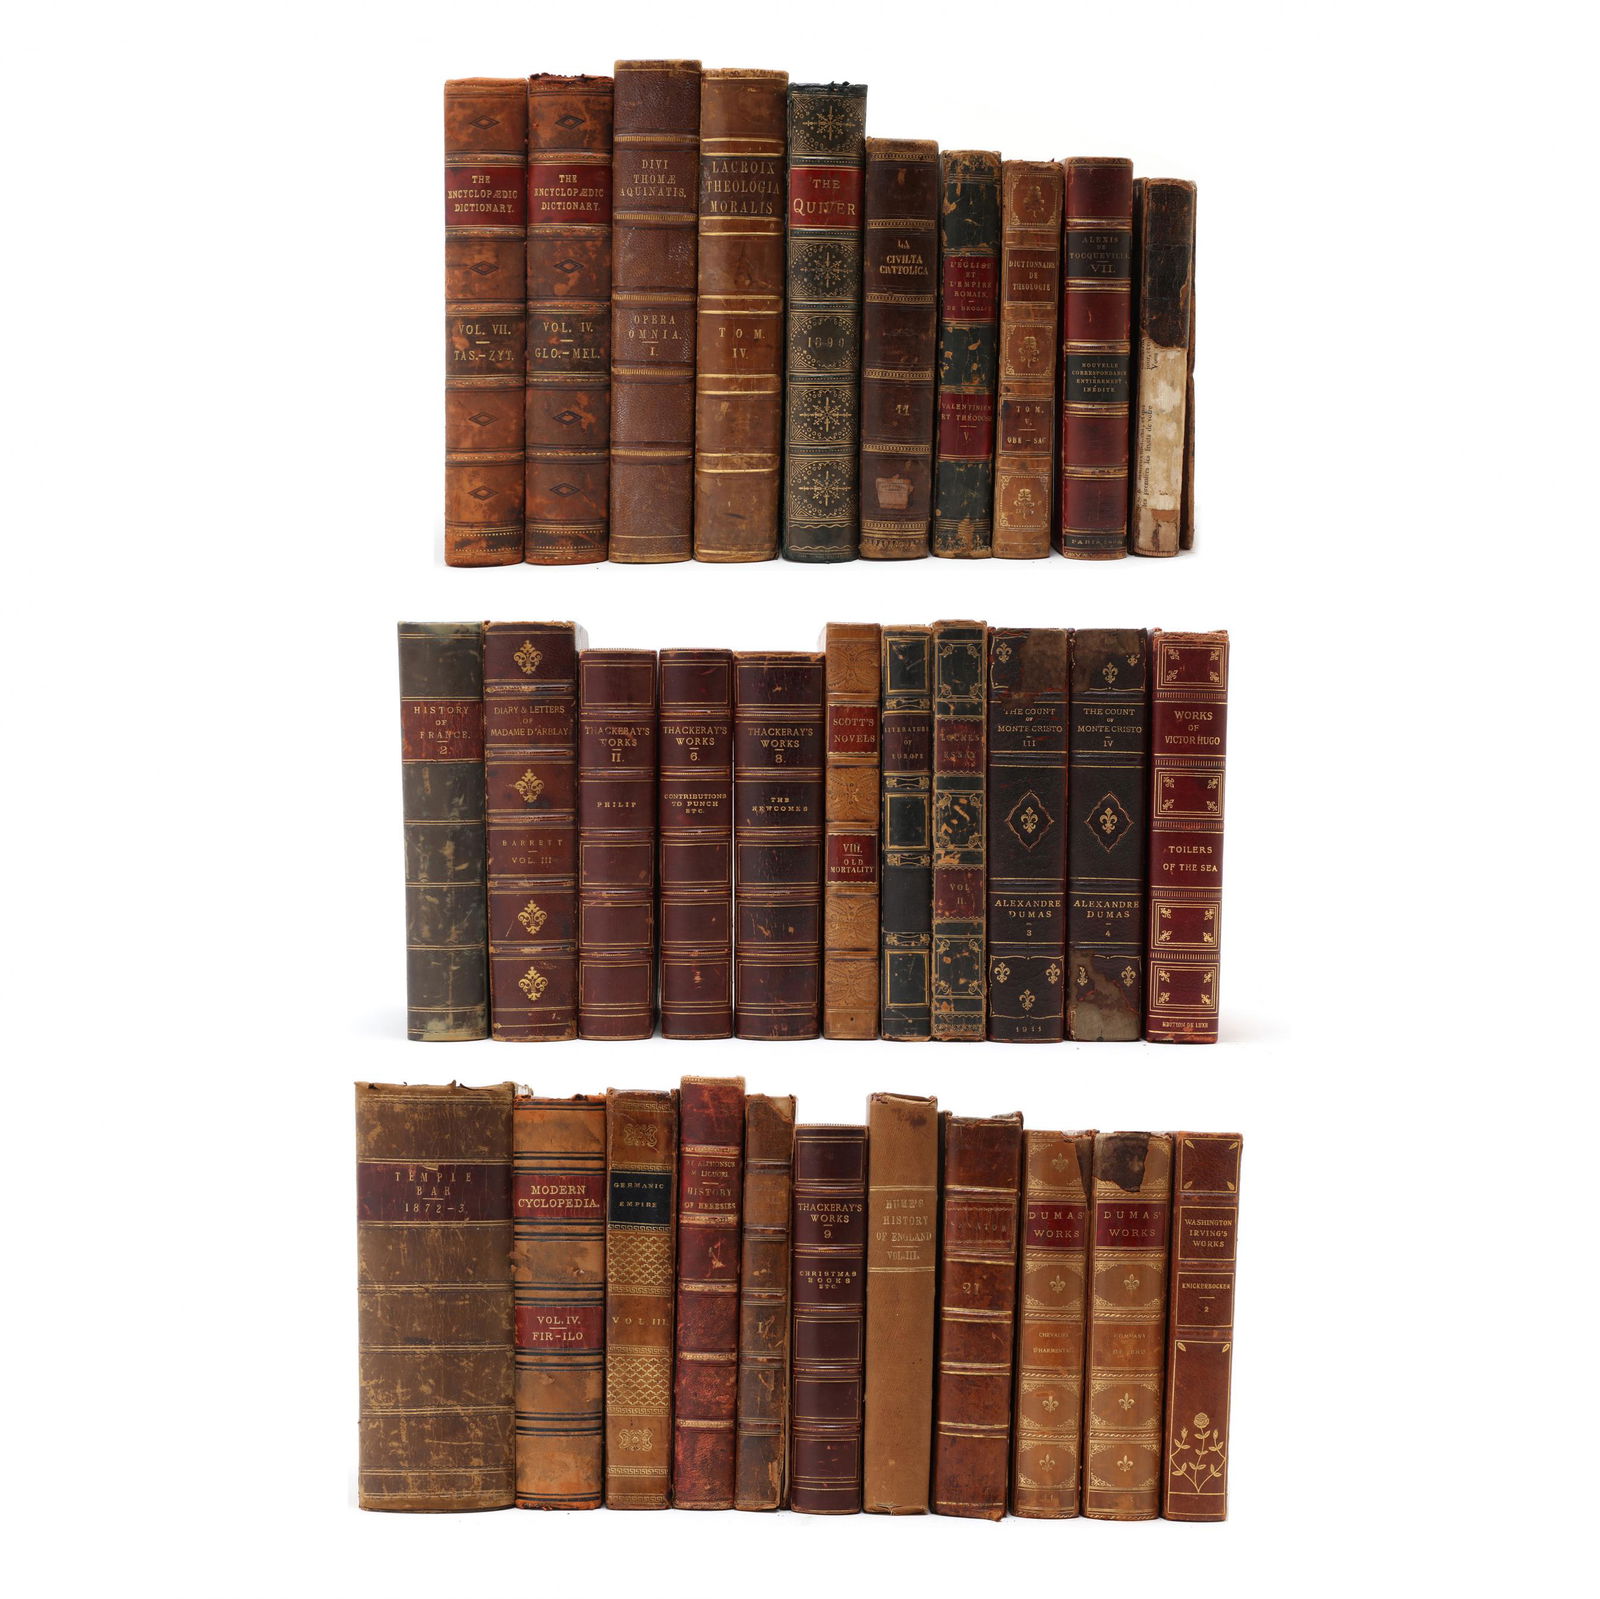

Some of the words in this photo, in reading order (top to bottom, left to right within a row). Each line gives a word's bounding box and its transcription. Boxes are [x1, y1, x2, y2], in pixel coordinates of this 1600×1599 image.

[642, 160, 668, 170] DIVI
[712, 162, 775, 175] LACROIX
[472, 175, 490, 184] THE
[559, 174, 577, 183] THE
[706, 180, 780, 193] THEOLOGIA
[812, 179, 840, 189] THE
[620, 187, 687, 197] AQUINATIS.
[454, 203, 514, 213] DICTIONARY.
[541, 201, 600, 211] DICTIONARY.
[710, 201, 773, 214] MORALIS
[898, 240, 910, 249] LA
[634, 314, 675, 325] OPERA
[459, 325, 485, 335] VOL.
[492, 325, 511, 335] VII.
[543, 322, 572, 333] VOL.
[580, 322, 594, 332] IV.
[629, 329, 682, 339] OMNIA.
[733, 348, 748, 358] IV.
[530, 706, 564, 714] LETTERS
[1174, 711, 1213, 720] WORKS
[833, 718, 874, 727] SCOTT'S
[420, 731, 471, 739] FRANCE.
[585, 726, 650, 736] THACKERAY'S
[664, 726, 727, 735] THACKERAY'S
[748, 728, 813, 736] THACKERAY'S
[676, 738, 715, 746] WORKS
[834, 735, 875, 743] NOVELS
[1165, 736, 1196, 744] VICTOR
[1197, 736, 1220, 745] HUGO
[761, 740, 800, 748] WORKS
[775, 755, 786, 763] 8.
[1169, 846, 1213, 854] TOILERS
[1201, 864, 1217, 872] SEA
[1073, 900, 1140, 908] ALEXANDRE
[395, 1172, 472, 1182] TEMPLE
[417, 1186, 450, 1195] BAR
[531, 1186, 585, 1195] MODERN
[687, 1187, 731, 1196] HISTORY
[518, 1199, 600, 1208] CYCLOPEDIA.
[798, 1203, 862, 1212] THACKERAY'S
[810, 1215, 849, 1223] WORKS
[883, 1216, 928, 1225] HISTORY
[891, 1232, 932, 1241] ENGLAND
[1034, 1230, 1080, 1238] WORKS
[1109, 1229, 1156, 1237] WORKS
[537, 1316, 563, 1325] VOL.
[567, 1316, 581, 1324] IV.
